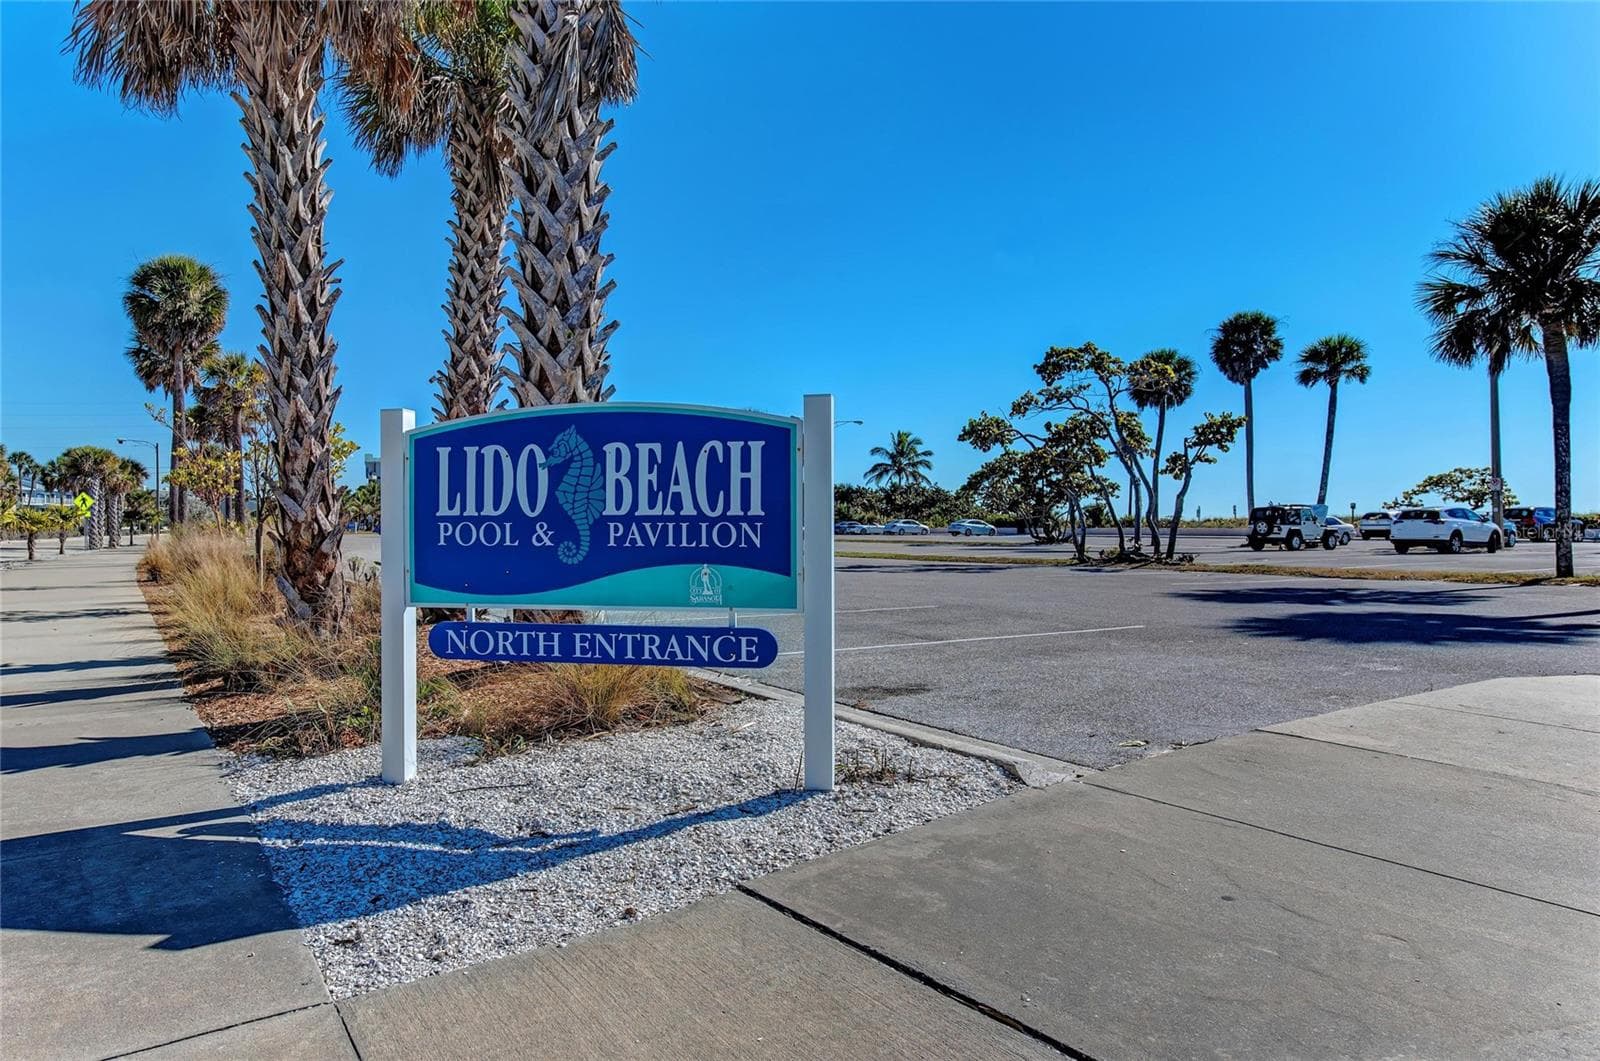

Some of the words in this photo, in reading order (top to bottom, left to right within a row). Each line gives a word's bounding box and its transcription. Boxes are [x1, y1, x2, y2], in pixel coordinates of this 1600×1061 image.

[436, 443, 548, 517] LIDO
[603, 440, 765, 517] BEACH
[437, 522, 519, 547] POOL
[532, 522, 555, 547] &
[607, 522, 762, 548] PAVILION
[445, 629, 560, 657] NORTH
[574, 632, 760, 667] ENTRANCE
